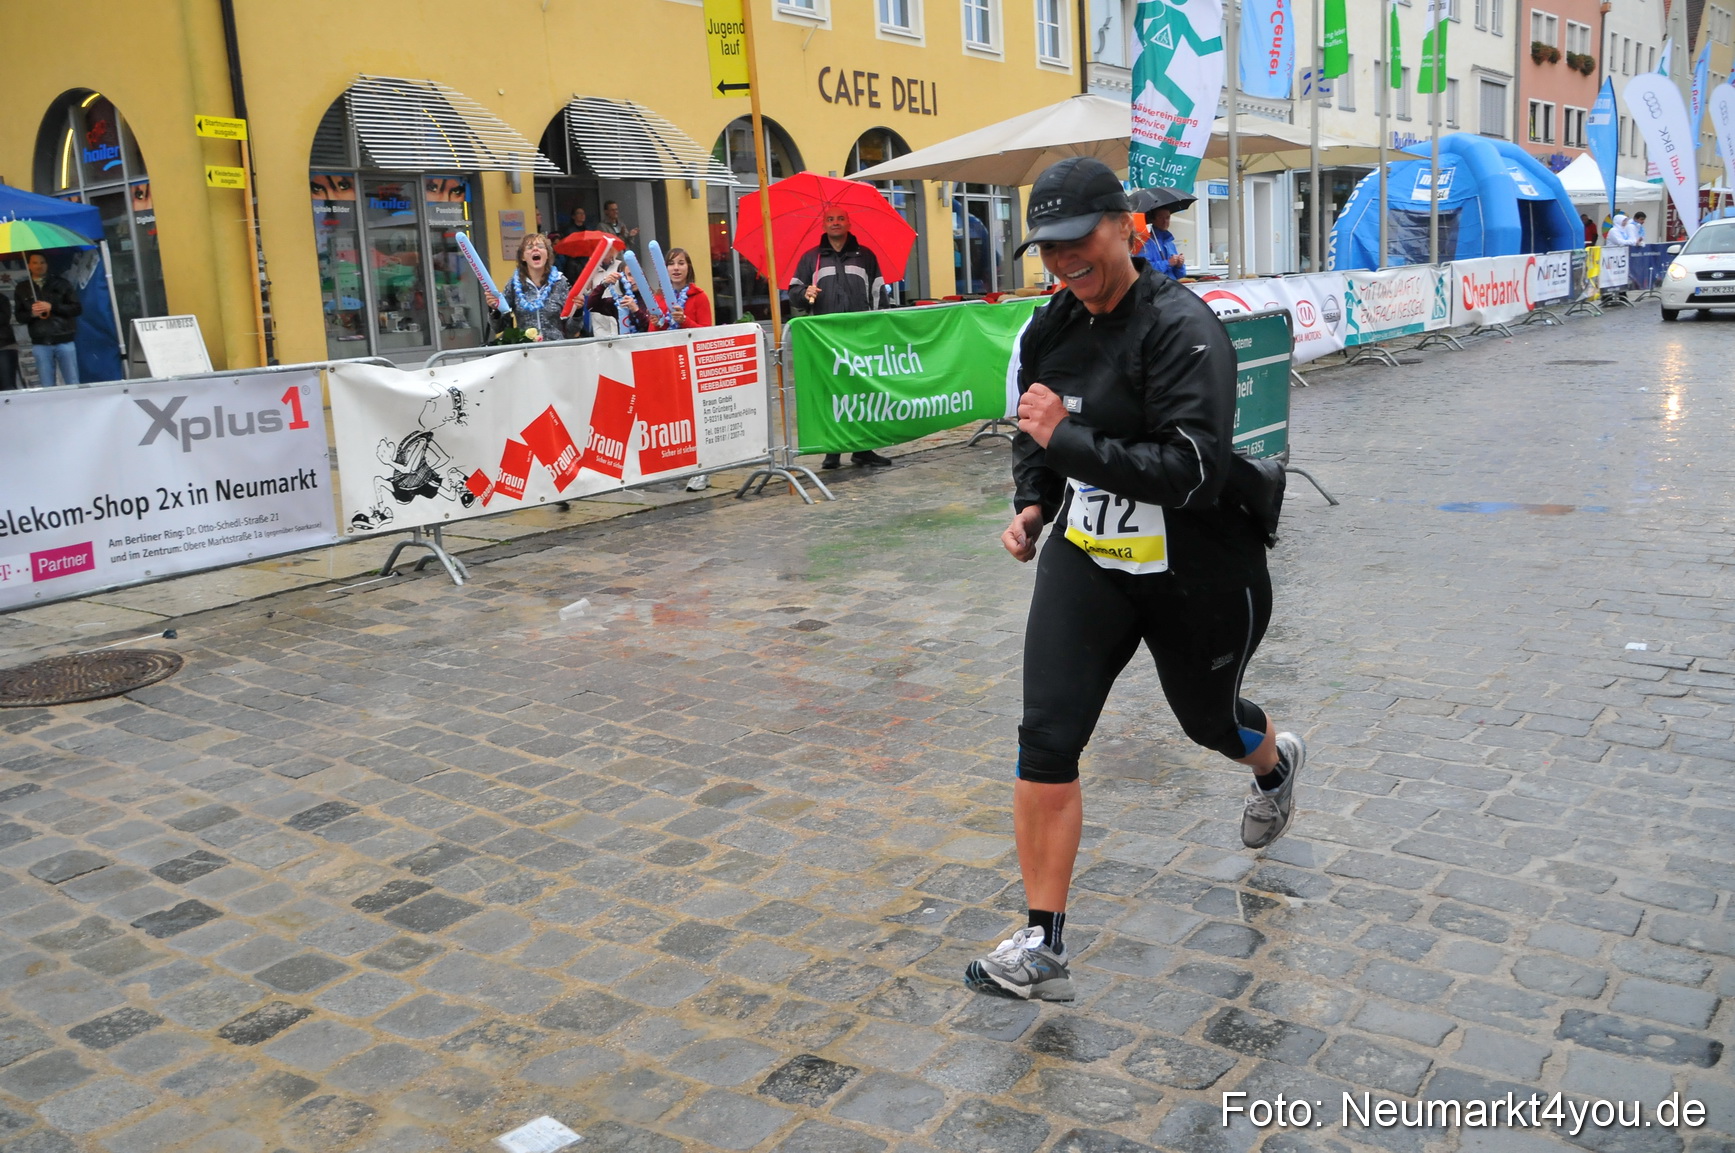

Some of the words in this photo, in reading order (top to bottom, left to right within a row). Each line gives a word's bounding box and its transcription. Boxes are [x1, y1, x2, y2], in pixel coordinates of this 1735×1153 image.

[707, 18, 745, 40] Jugend
[720, 39, 740, 56] lauf
[818, 66, 881, 109] CAFE
[892, 76, 937, 116] DELI
[83, 144, 120, 164] hailer
[1418, 171, 1452, 185] mxi
[369, 197, 412, 209] hailer
[1462, 267, 1520, 311] Oberbank
[1299, 306, 1314, 321] KIA
[696, 338, 736, 351] BINDESTRICKE
[1304, 330, 1322, 342] MOTORS
[831, 342, 924, 378] Herzlich
[702, 398, 718, 407] Braun
[718, 395, 733, 404] GmbH
[703, 407, 711, 415] Am
[831, 388, 974, 423] Willkommen
[133, 385, 310, 453] Xplus1
[585, 424, 624, 461] Braun
[636, 418, 692, 452] Braun
[705, 436, 714, 445] Fax
[544, 444, 577, 483] Braun
[661, 449, 676, 459] Sicher
[155, 487, 184, 511] 2x
[187, 482, 209, 506] in
[215, 467, 318, 502] Neumarkt
[496, 467, 525, 490] Braun
[108, 538, 123, 548] Am
[125, 532, 162, 546] Berliner
[163, 528, 185, 540] Ring:
[186, 526, 197, 536] Dr.
[269, 513, 280, 522] 21
[110, 553, 127, 564] und
[129, 550, 140, 560] im
[142, 545, 183, 558] Zentrum:
[183, 540, 206, 552] Obere
[207, 531, 253, 547] Marktstraße
[254, 529, 263, 539] 1a
[38, 552, 88, 574] Partner
